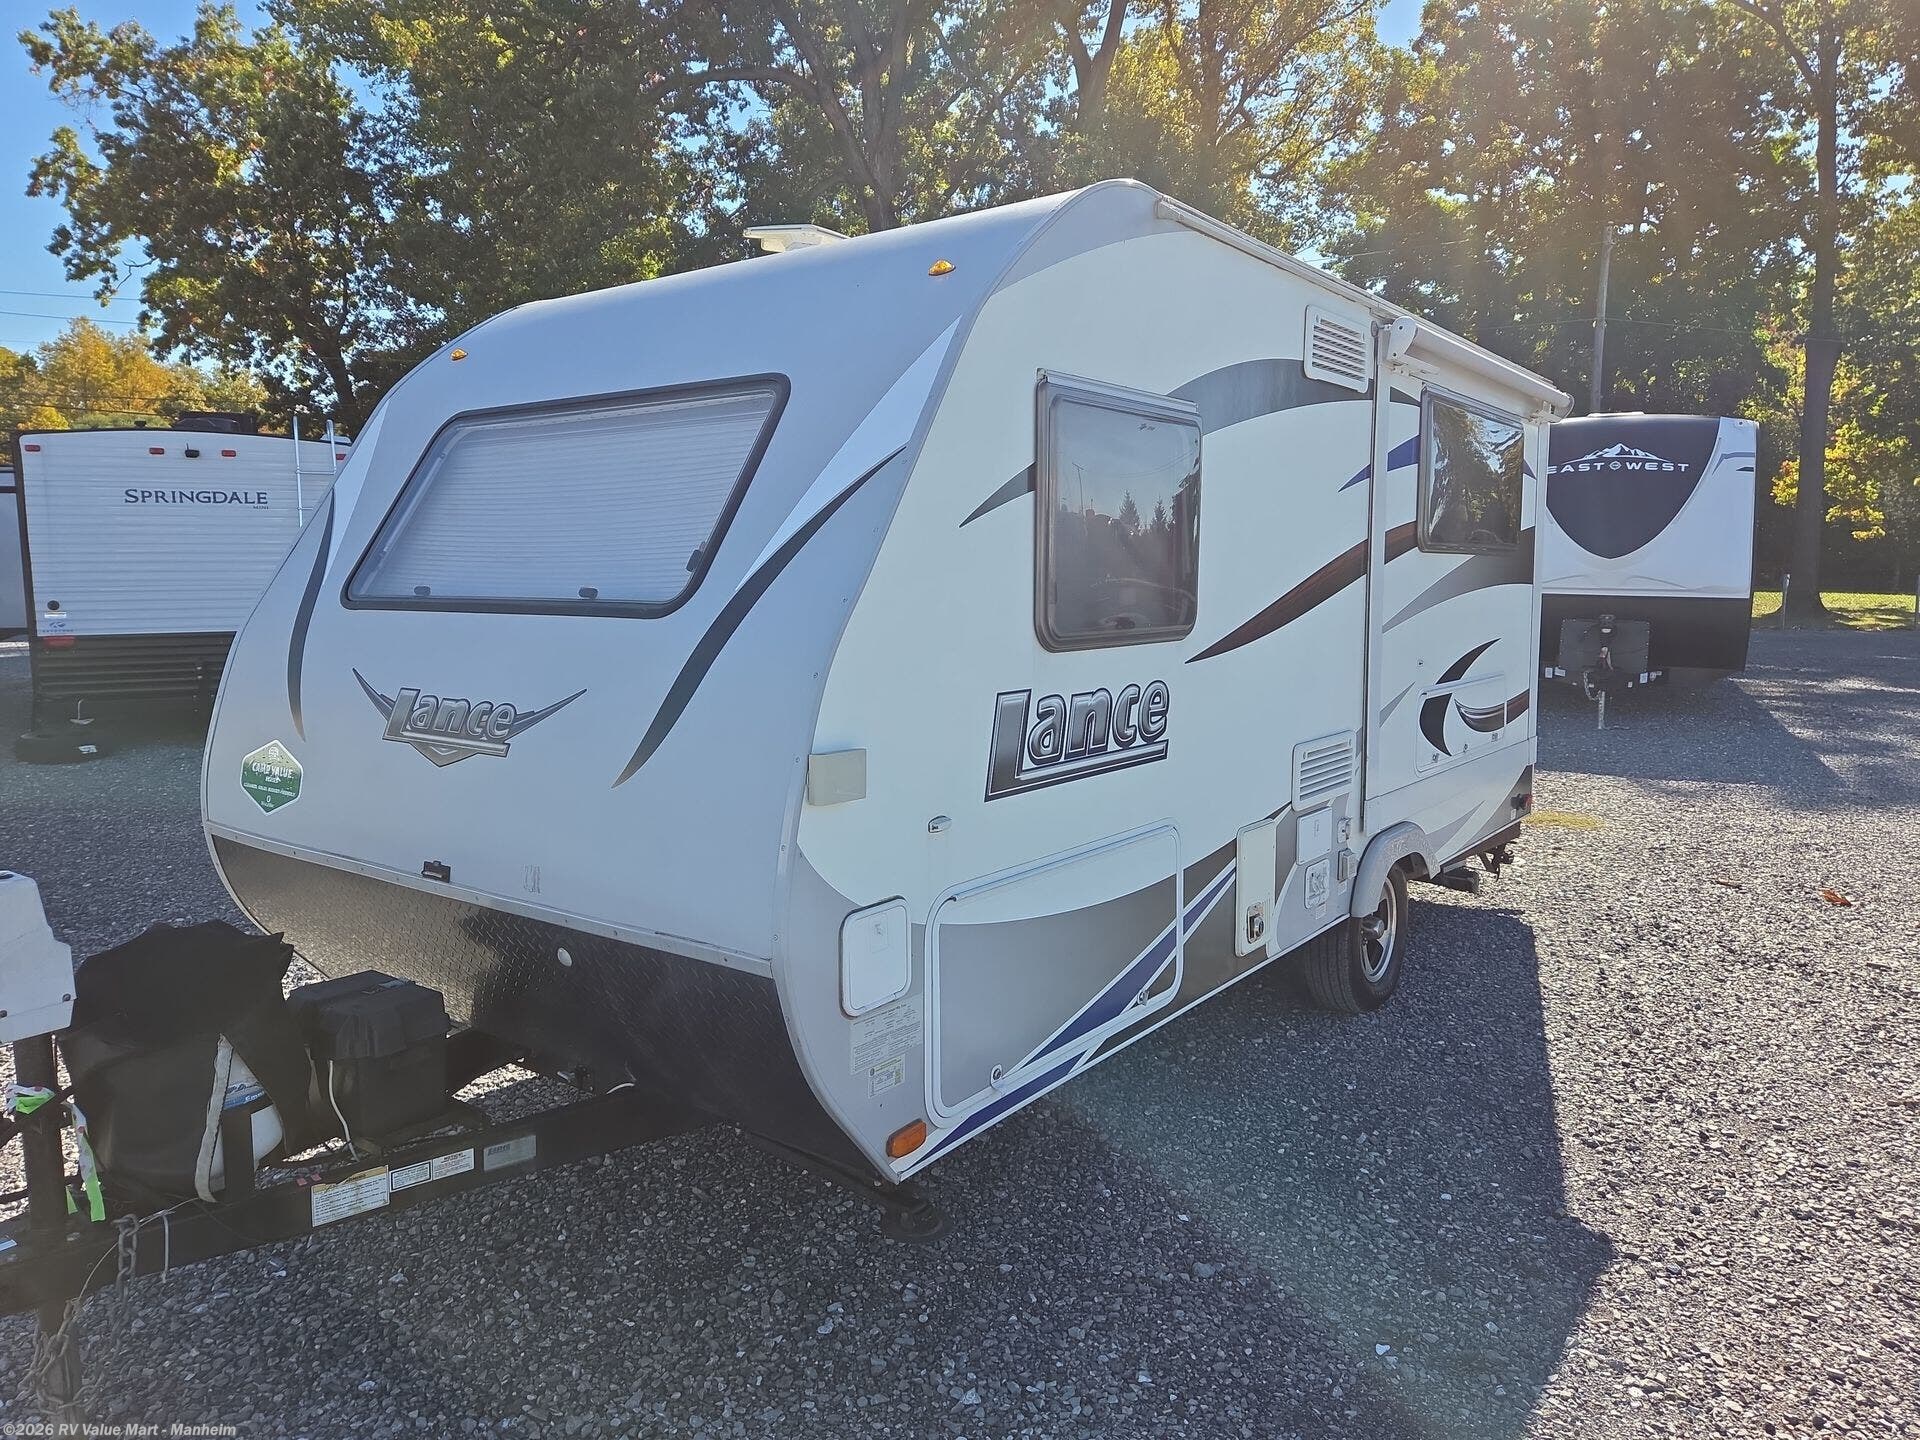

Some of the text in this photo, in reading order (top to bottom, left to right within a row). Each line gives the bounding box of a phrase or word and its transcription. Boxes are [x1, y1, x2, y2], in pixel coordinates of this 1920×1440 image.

[1547, 462, 1690, 475] EAST WEST
[124, 488, 268, 505] SPRINGDALE
[382, 687, 518, 757] Lance
[984, 679, 1170, 803] Lance
